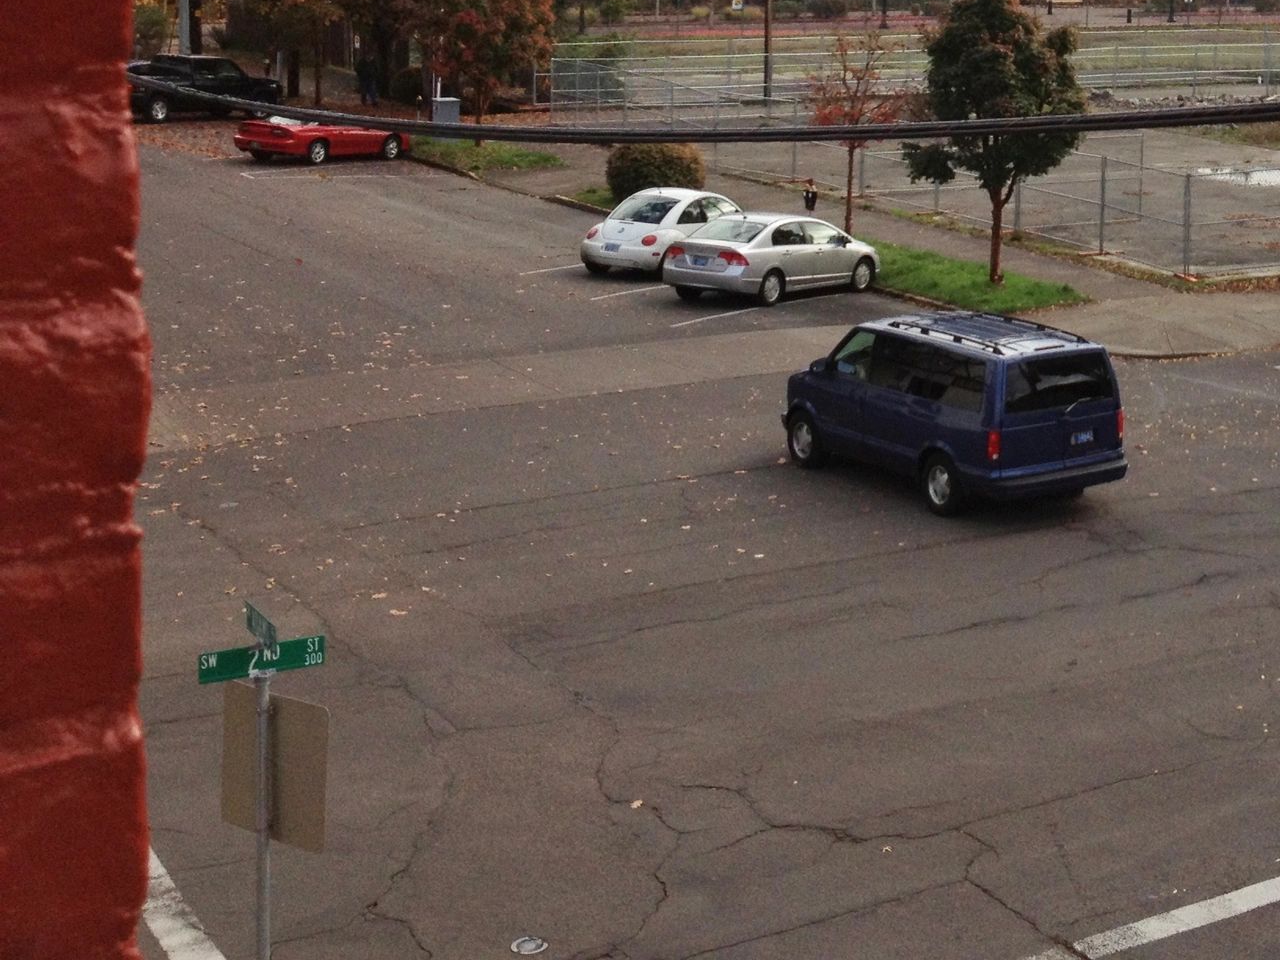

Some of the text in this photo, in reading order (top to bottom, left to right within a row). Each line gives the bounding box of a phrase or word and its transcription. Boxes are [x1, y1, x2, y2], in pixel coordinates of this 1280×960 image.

[201, 654, 218, 670] SW
[307, 637, 320, 652] ST
[304, 652, 323, 666] 300
